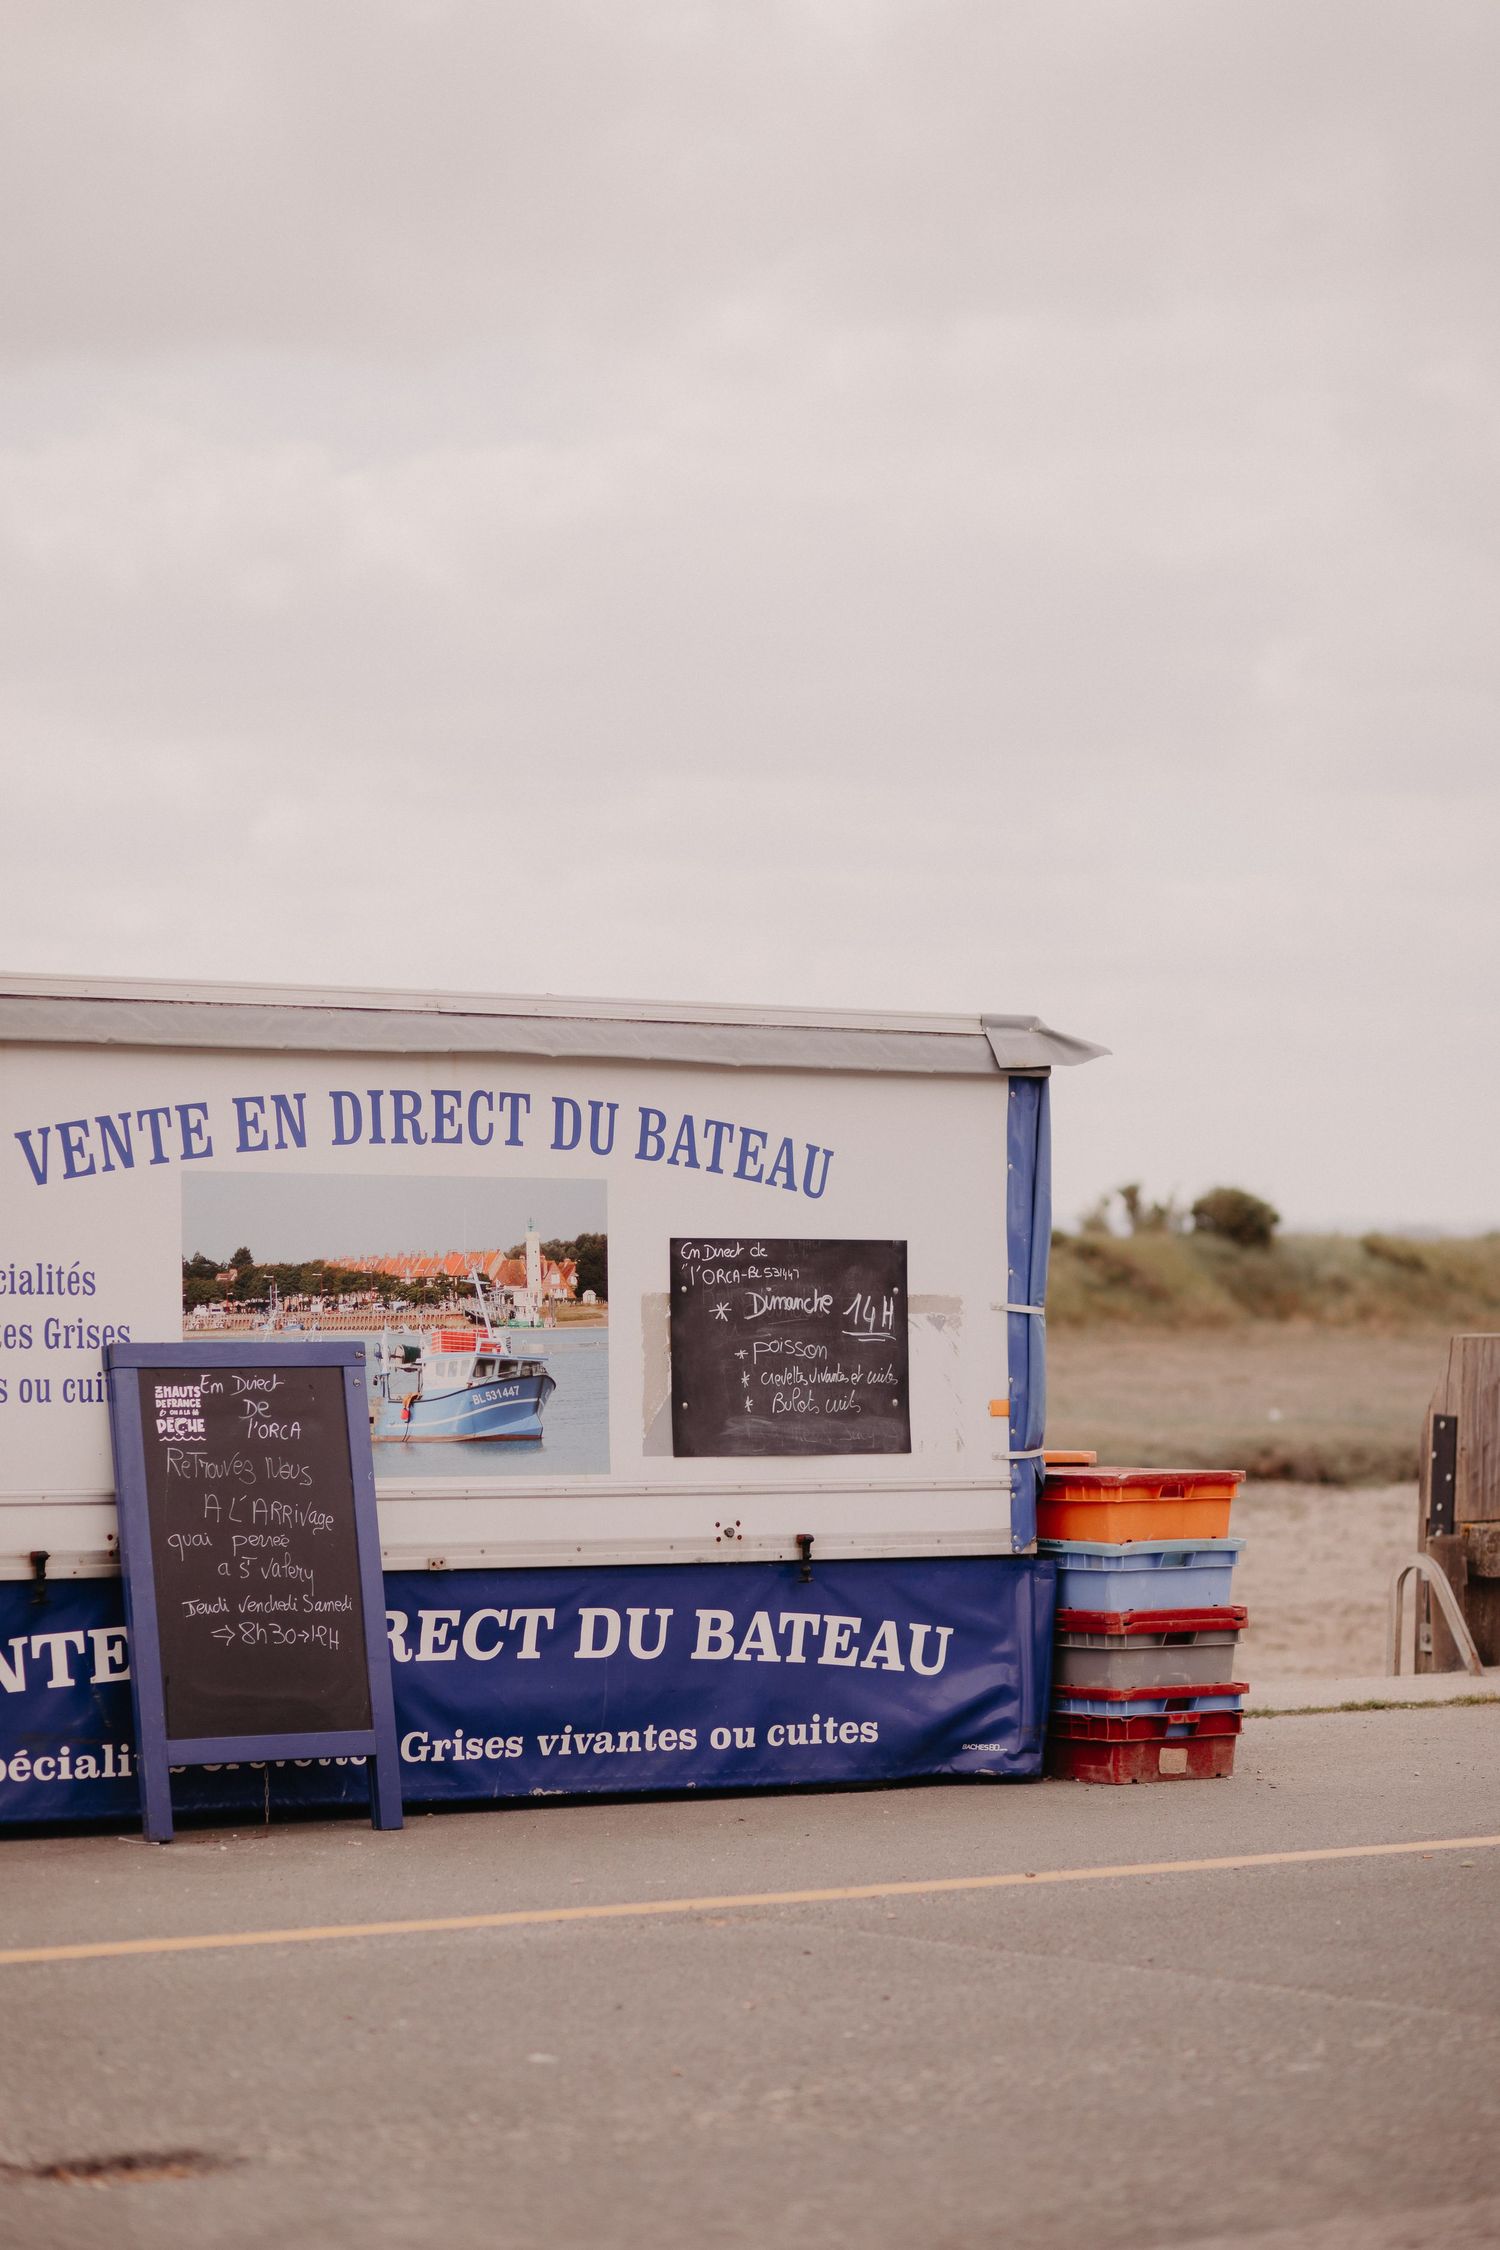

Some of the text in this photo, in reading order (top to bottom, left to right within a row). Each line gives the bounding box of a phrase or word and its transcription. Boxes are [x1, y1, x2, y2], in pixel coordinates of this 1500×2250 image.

[14, 1089, 835, 1199] VENTE EN DIRECT DU BATEAU
[702, 1242, 744, 1261] Direct
[749, 1242, 768, 1257] de
[743, 1287, 833, 1320] Dimanche
[19, 1378, 52, 1404] ou
[62, 1371, 111, 1404] cui
[163, 1385, 202, 1398] HAUTS
[230, 1373, 285, 1396] Direct
[166, 1398, 202, 1408] FRANCE
[204, 1493, 222, 1523] A
[167, 1532, 213, 1562] quai
[302, 1593, 353, 1614] Samedi
[574, 1607, 673, 1660] DU
[690, 1609, 954, 1676] BATEAU
[400, 1729, 523, 1763] Grises
[537, 1714, 698, 1756] vivantes
[710, 1727, 756, 1750] ou
[767, 1713, 879, 1747] cuites
